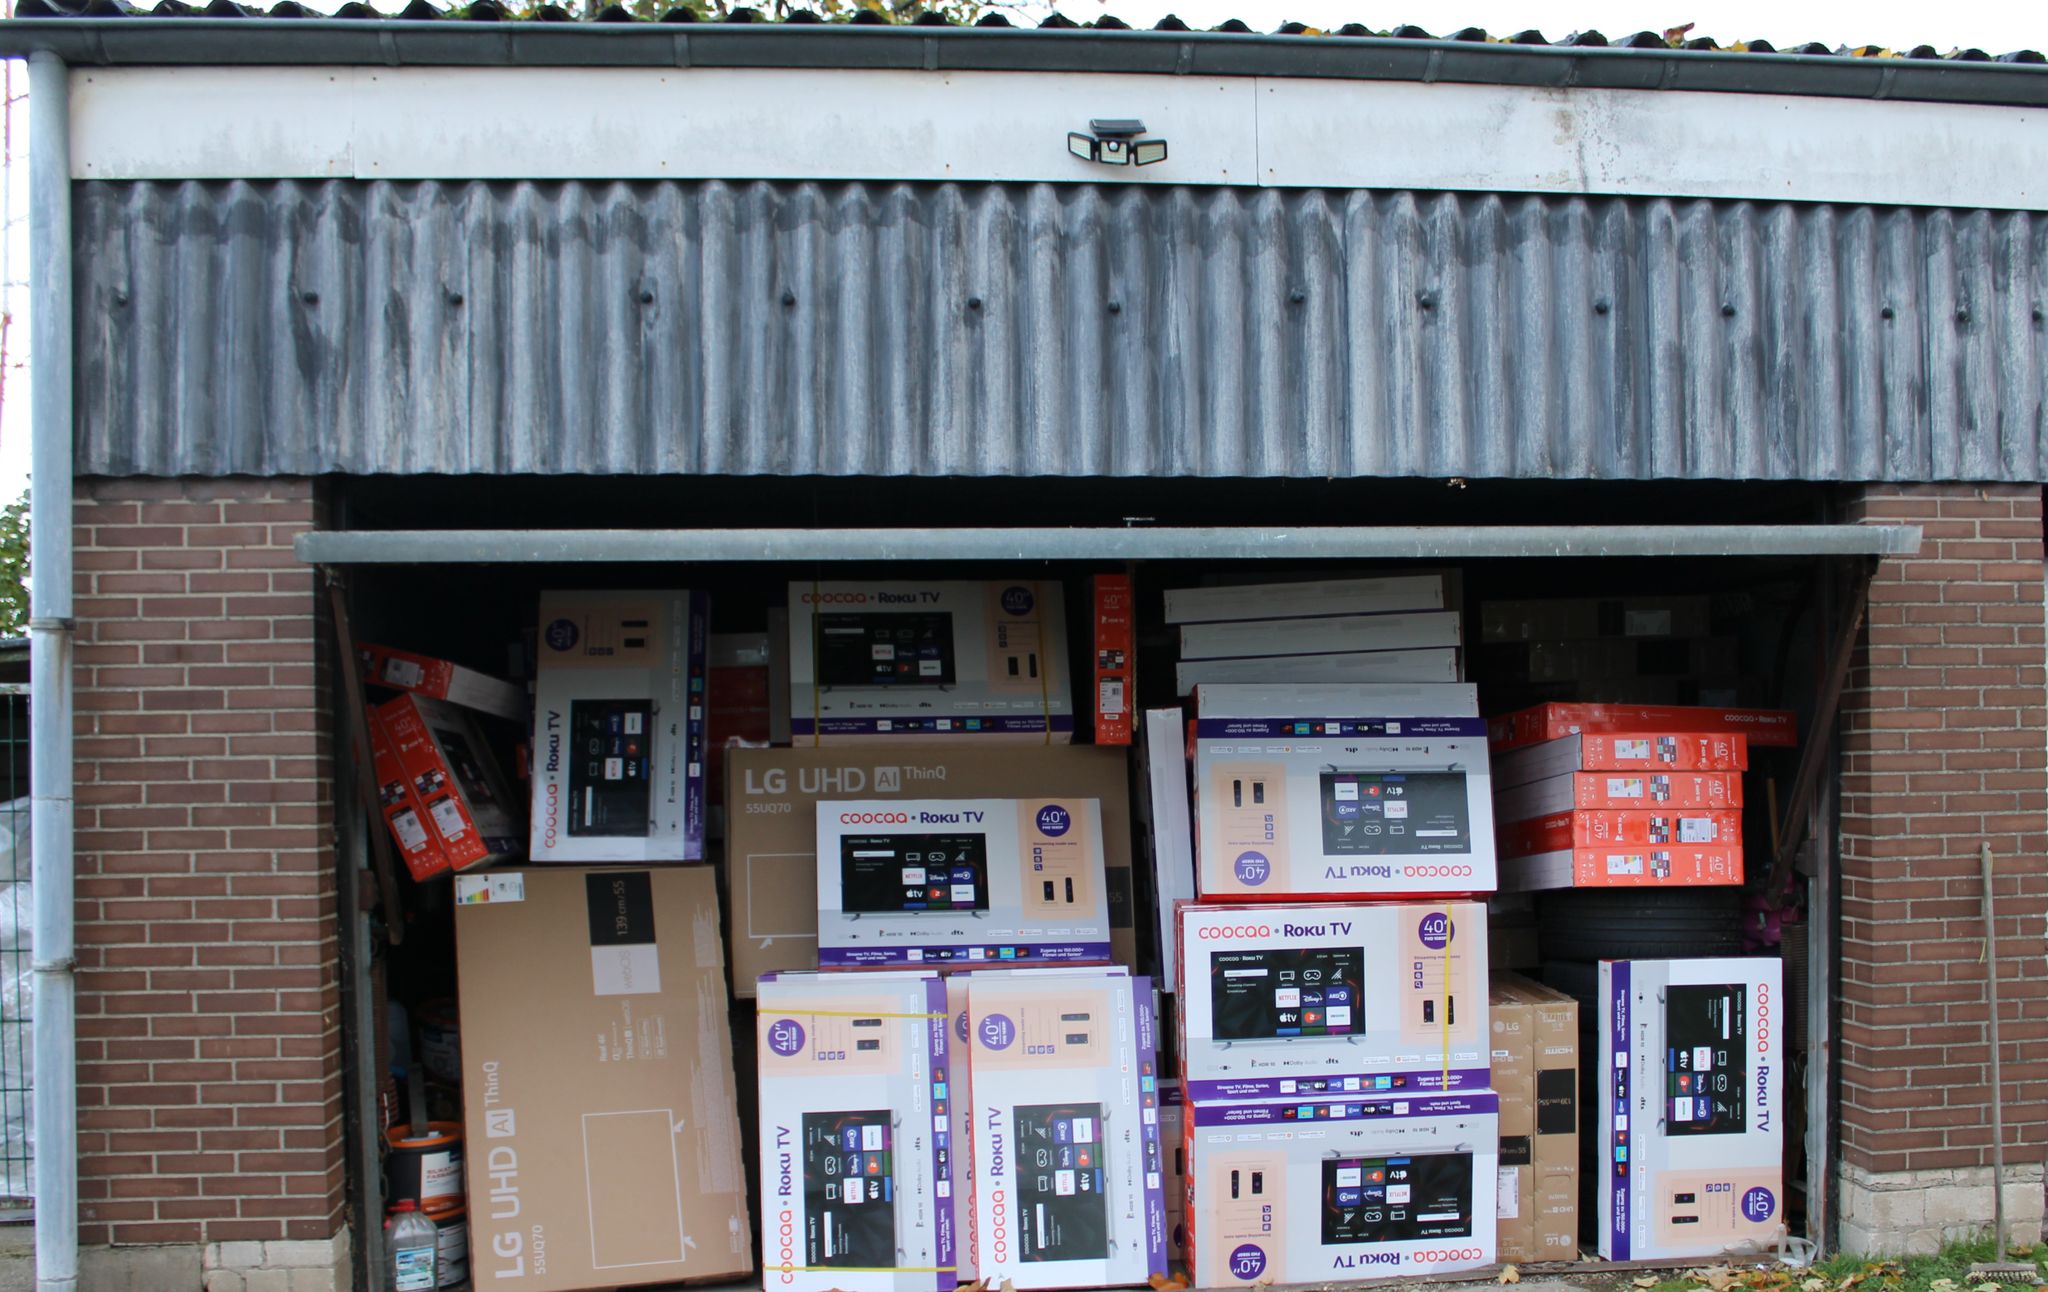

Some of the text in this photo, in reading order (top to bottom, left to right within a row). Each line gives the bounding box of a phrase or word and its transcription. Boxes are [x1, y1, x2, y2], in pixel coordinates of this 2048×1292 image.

[878, 592, 916, 602] Roku
[919, 591, 940, 602] TV
[544, 710, 560, 847] coocaa Roku TV
[745, 765, 946, 795] LG UHD AI ThinQ
[1386, 786, 1395, 795] tv
[745, 802, 792, 814] 55UQ70
[840, 811, 983, 824] coocaa Roku TV
[1324, 865, 1471, 879] coocaa Roku TV
[913, 889, 922, 897] tv
[616, 916, 629, 936] 139
[1198, 921, 1351, 939] coocaa Roku TV
[1287, 1012, 1296, 1022] tv
[1506, 1022, 1520, 1031] LG
[1679, 1058, 1688, 1068] tv
[1757, 983, 1768, 1131] coocaa Roku TV
[776, 1125, 790, 1148] TV
[482, 1061, 525, 1279] LG UHD AI ThinQ
[777, 1152, 791, 1195] Roku
[1389, 1170, 1399, 1179] tv
[1079, 1172, 1089, 1182] tv
[868, 1180, 878, 1190] tv
[987, 1107, 1007, 1263] coocaa Roku TV
[1546, 1236, 1559, 1246] LG
[532, 1224, 546, 1275] 55UQ70
[1332, 1247, 1482, 1268] coocaa Roku TV
